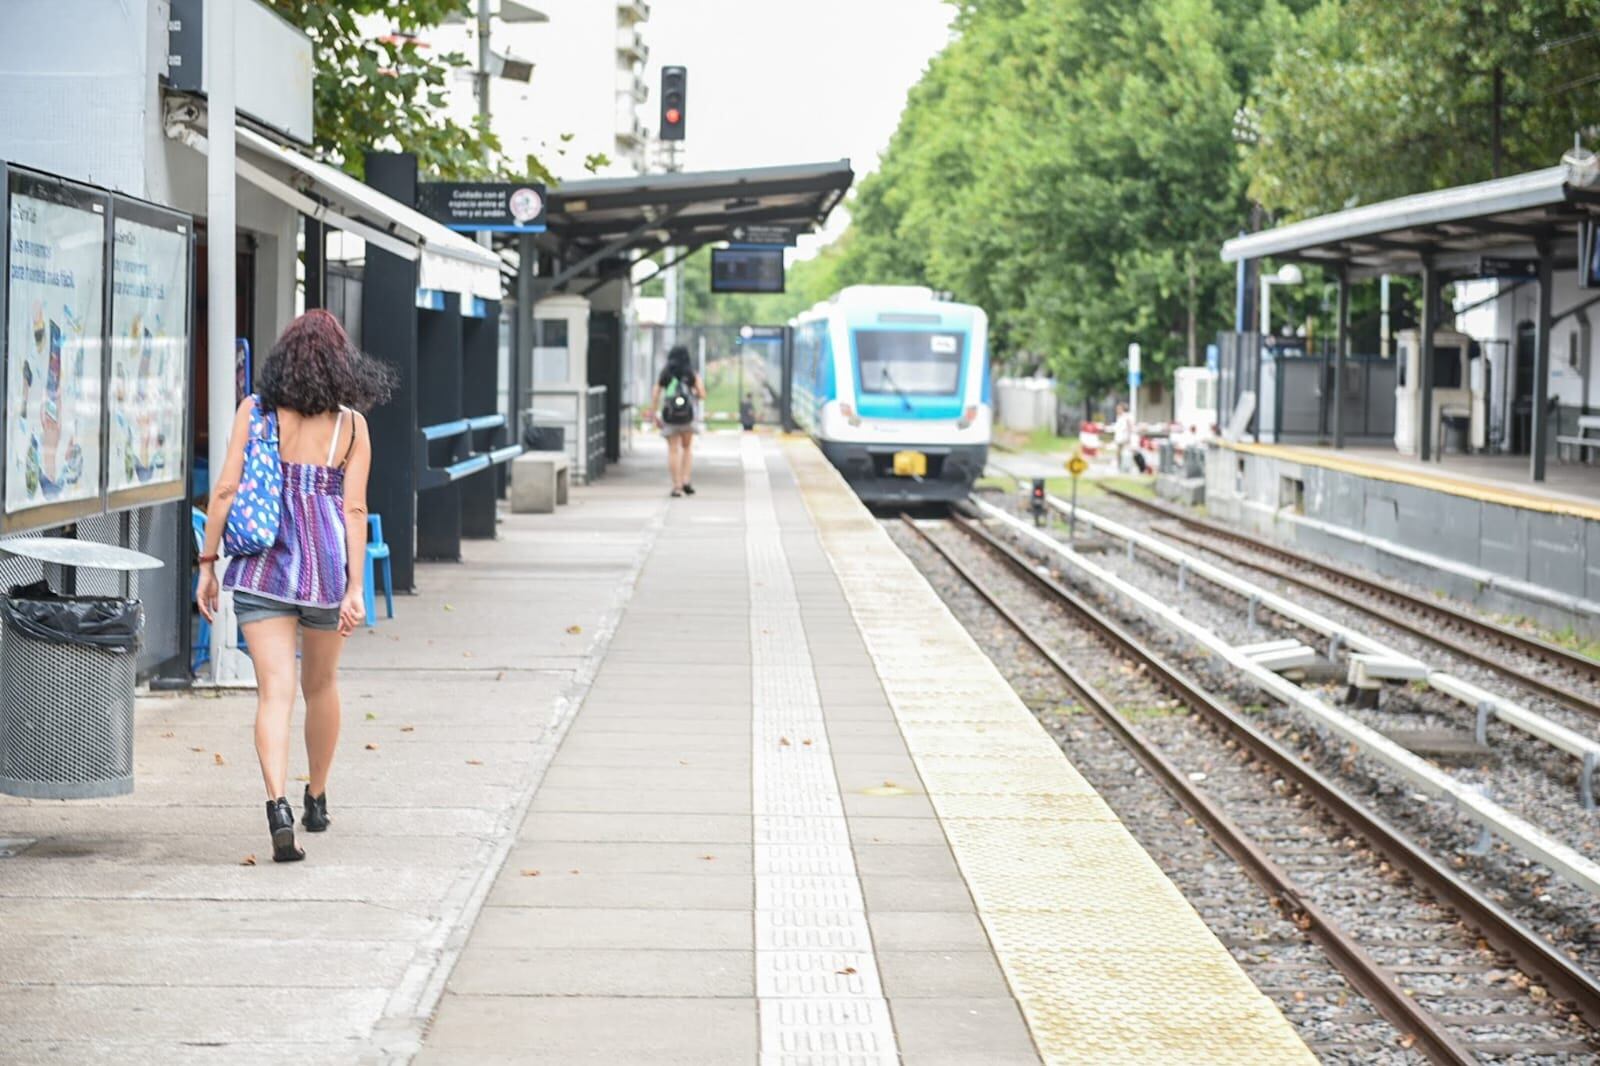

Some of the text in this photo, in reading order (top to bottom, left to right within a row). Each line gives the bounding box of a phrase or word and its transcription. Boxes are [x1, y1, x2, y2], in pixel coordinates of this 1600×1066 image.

[453, 190, 506, 199] Cuidado con el
[448, 200, 506, 209] espacio entre el
[452, 209, 468, 217] tren
[474, 209, 482, 217] el
